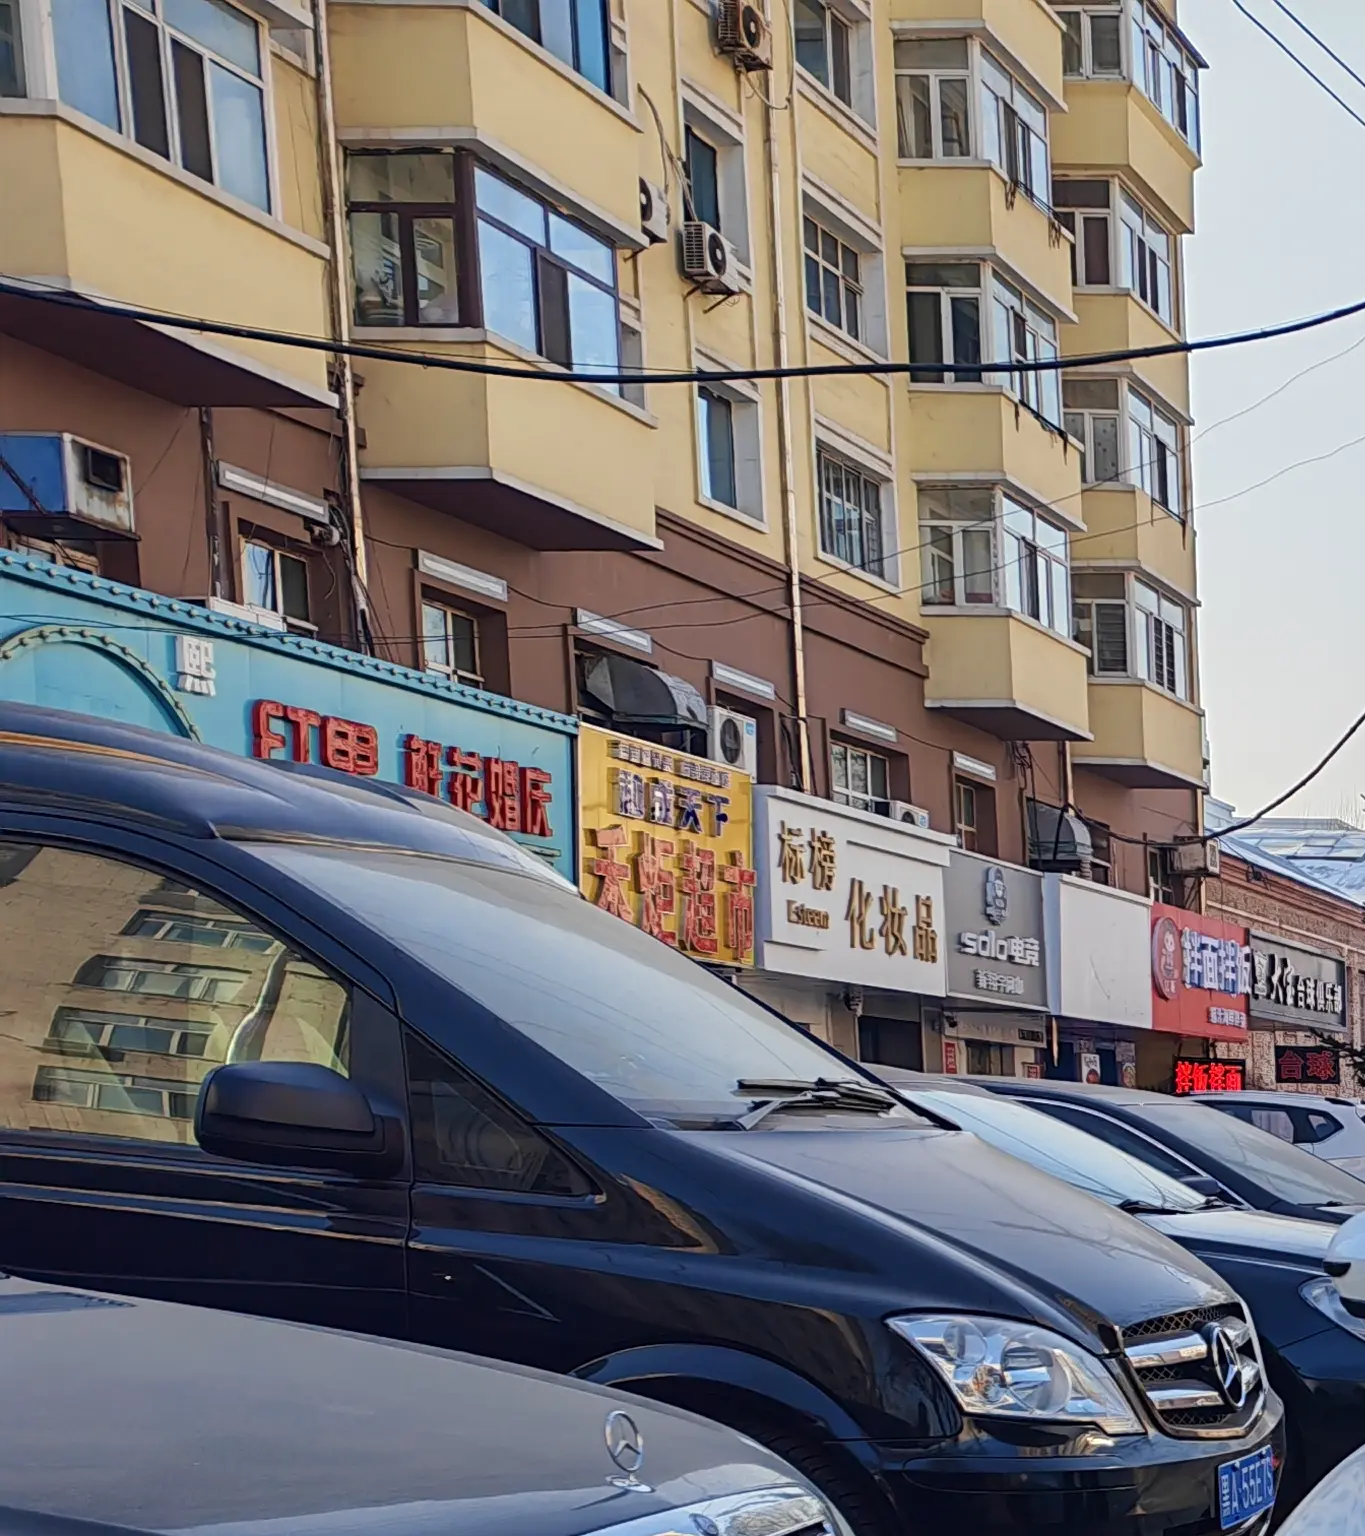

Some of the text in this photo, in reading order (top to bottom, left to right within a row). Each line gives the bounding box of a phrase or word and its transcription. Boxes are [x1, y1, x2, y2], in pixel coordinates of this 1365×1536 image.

[176, 635, 217, 697] 熙
[777, 820, 836, 891] 标榜
[845, 877, 938, 964] 化妆品
[1278, 1051, 1336, 1081] 台球
